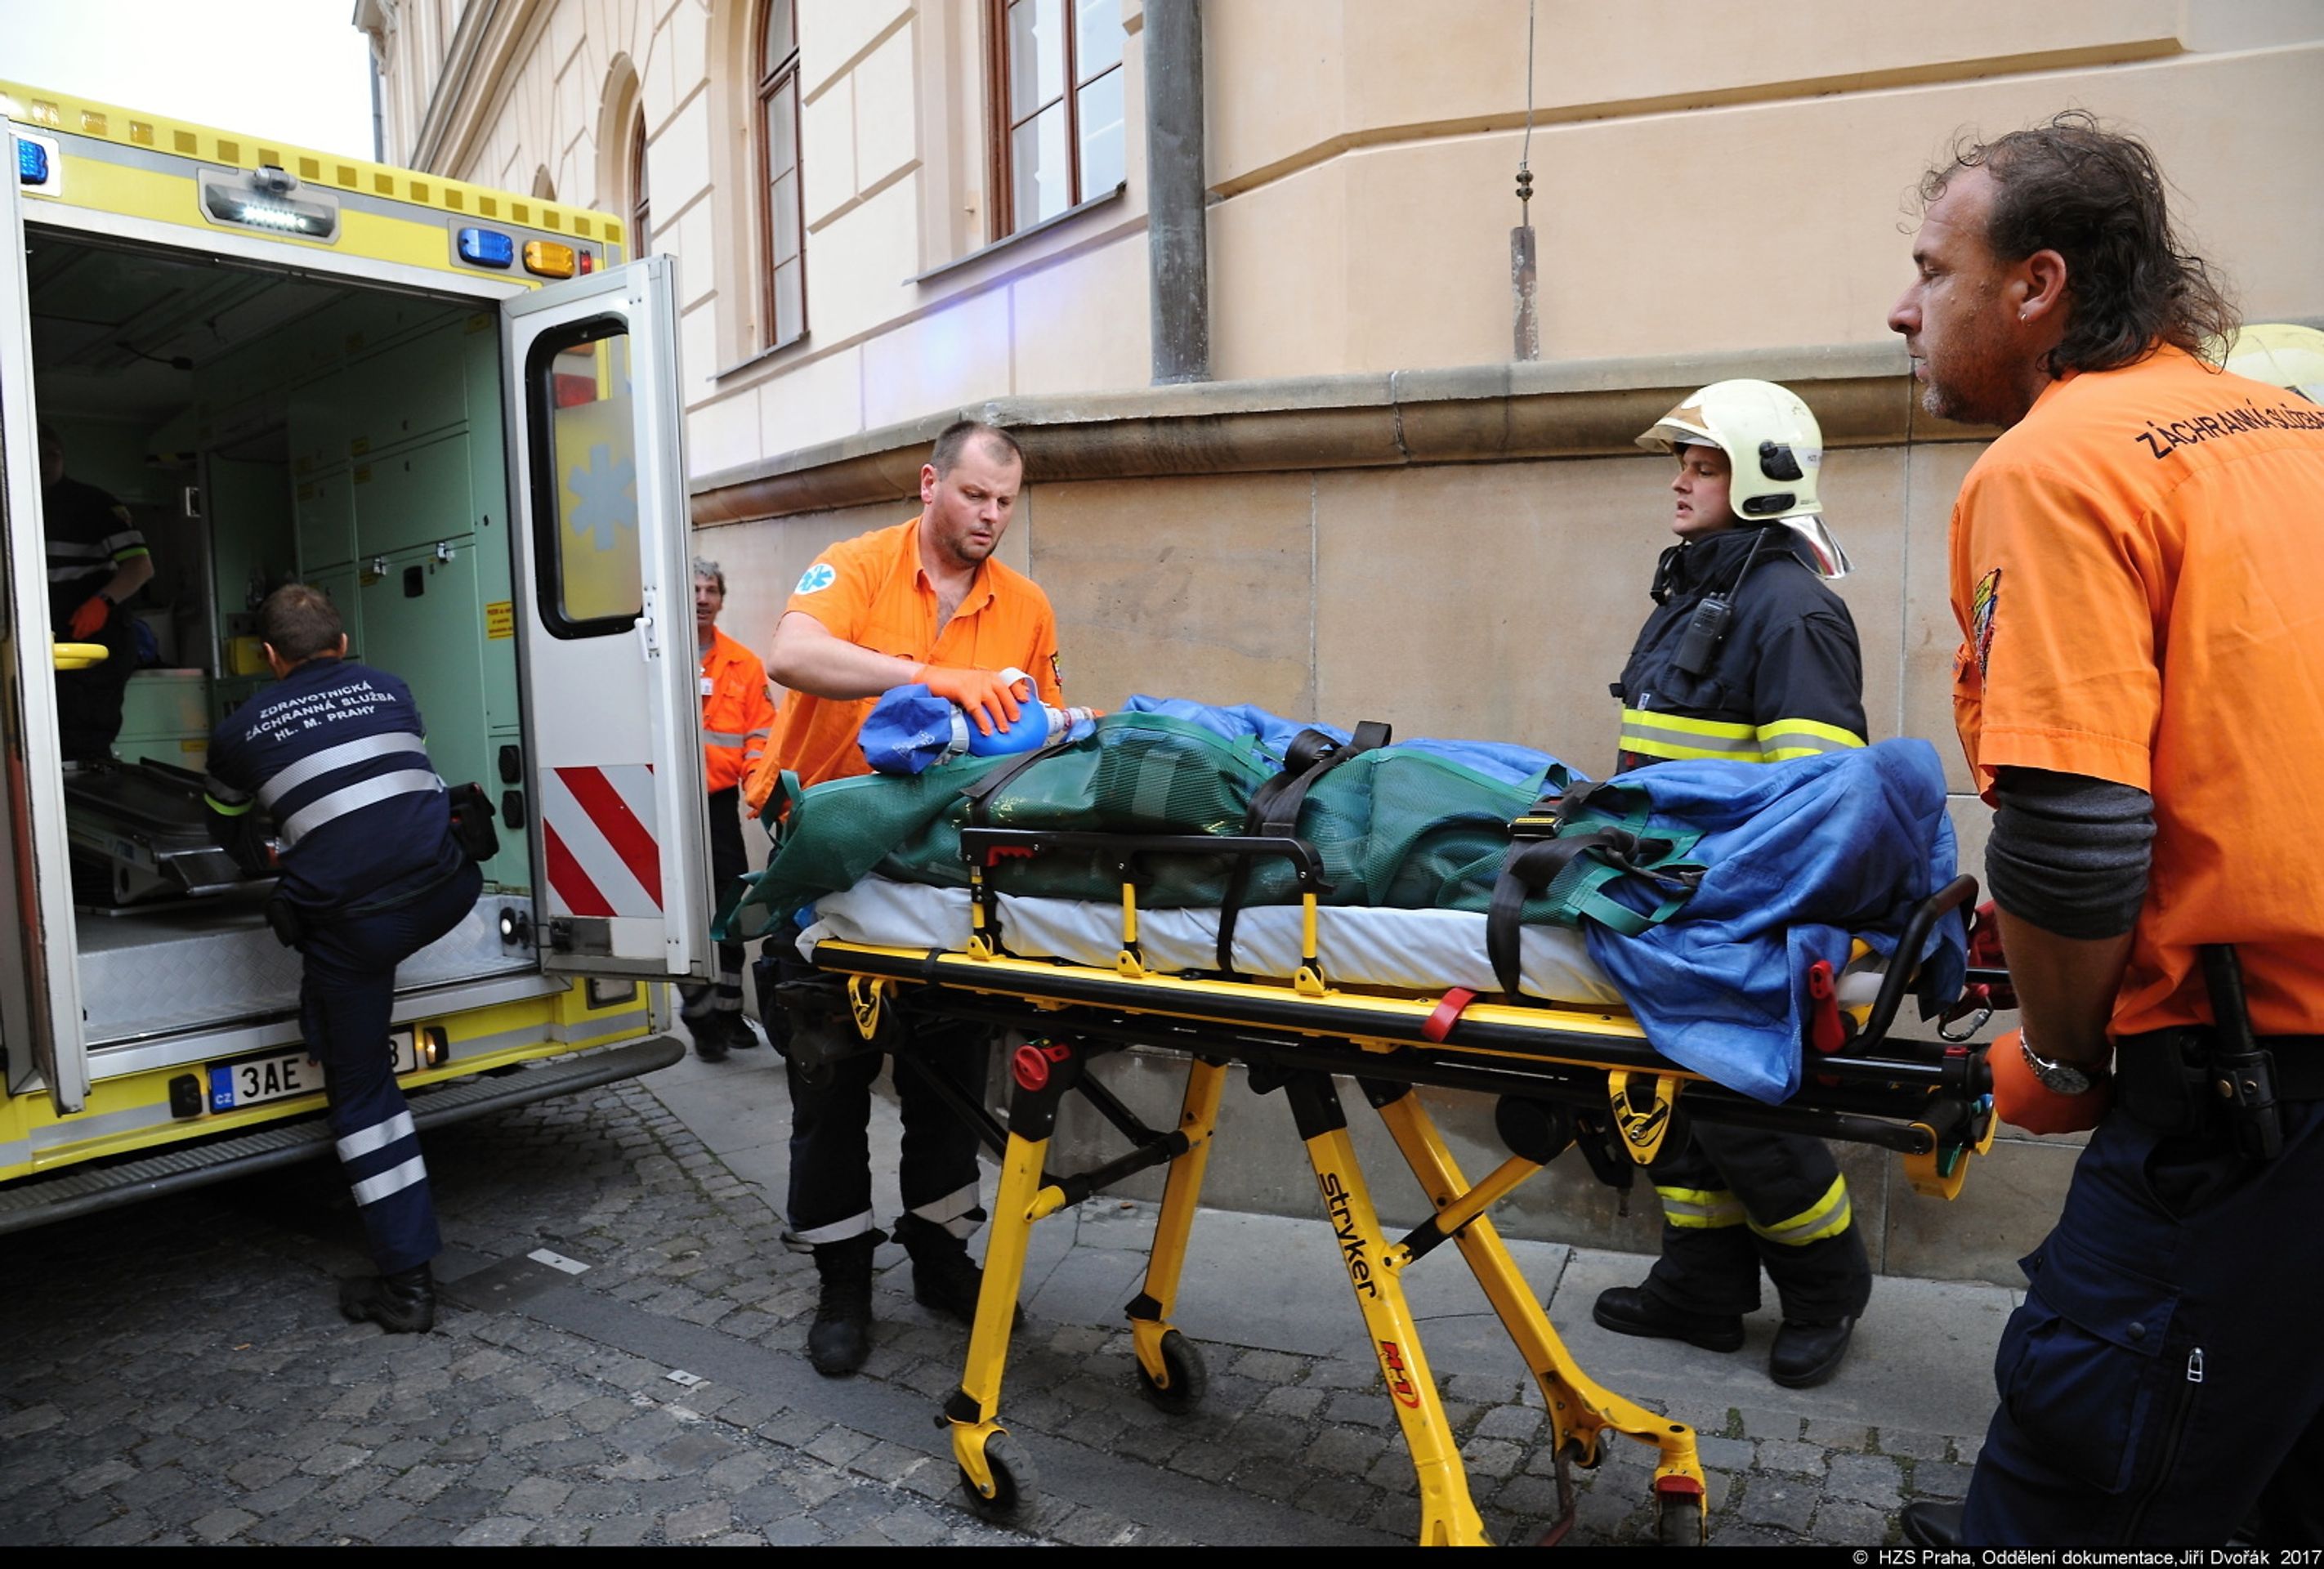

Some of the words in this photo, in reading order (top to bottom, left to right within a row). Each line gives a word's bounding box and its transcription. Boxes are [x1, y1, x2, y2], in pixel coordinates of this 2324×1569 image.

[2135, 398, 2278, 459] ZÁCHRANNÁ
[246, 700, 336, 741] ZÁCHRANNÁ
[341, 691, 396, 706] SLUŽBA
[259, 680, 373, 719] ZDRAVOTNICKÁ
[274, 727, 299, 741] HL.
[303, 717, 322, 729] M.
[327, 705, 376, 722] PRAHY
[215, 1093, 233, 1104] CZ
[1320, 1172, 1377, 1299] stryker
